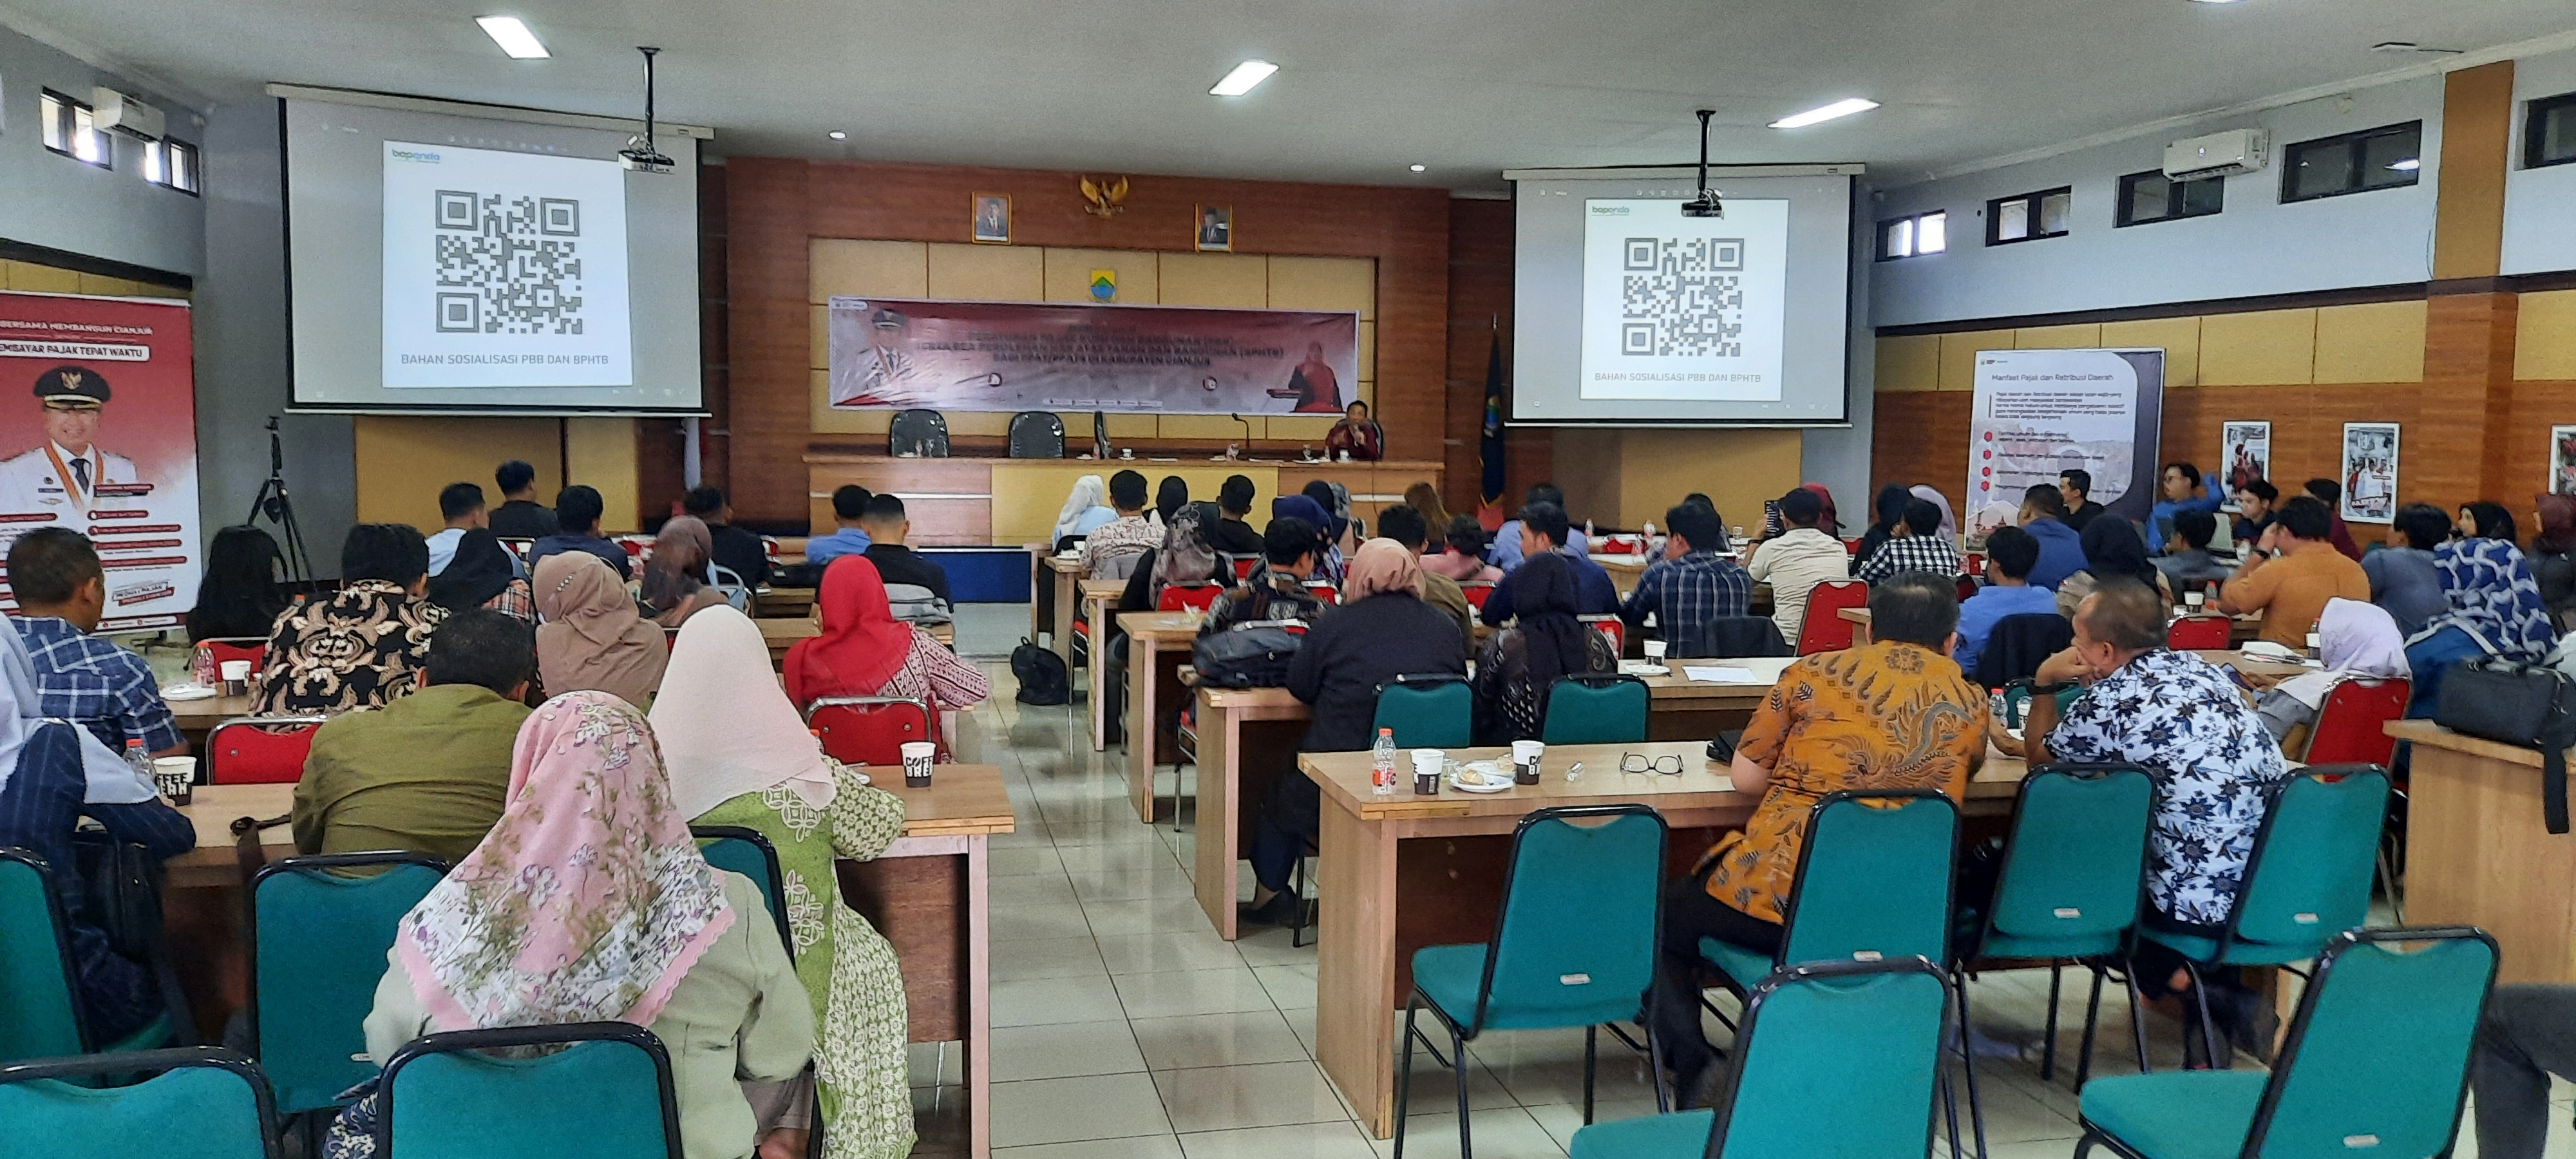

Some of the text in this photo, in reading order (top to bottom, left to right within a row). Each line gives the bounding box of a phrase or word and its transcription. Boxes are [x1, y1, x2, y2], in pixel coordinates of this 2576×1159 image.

[47, 345, 78, 354] PAJAK
[79, 346, 107, 355] TEPAT
[109, 348, 142, 357] WAKTU
[401, 354, 609, 365] BAHAN SOSIALISASI PBB DAN BPHTB
[1595, 373, 1626, 381] BAHAN
[1629, 373, 1685, 381] SOSIALISASI
[1687, 373, 1705, 382] PBB
[1730, 374, 1761, 383] BPHTB
[2021, 374, 2038, 382] Pajak
